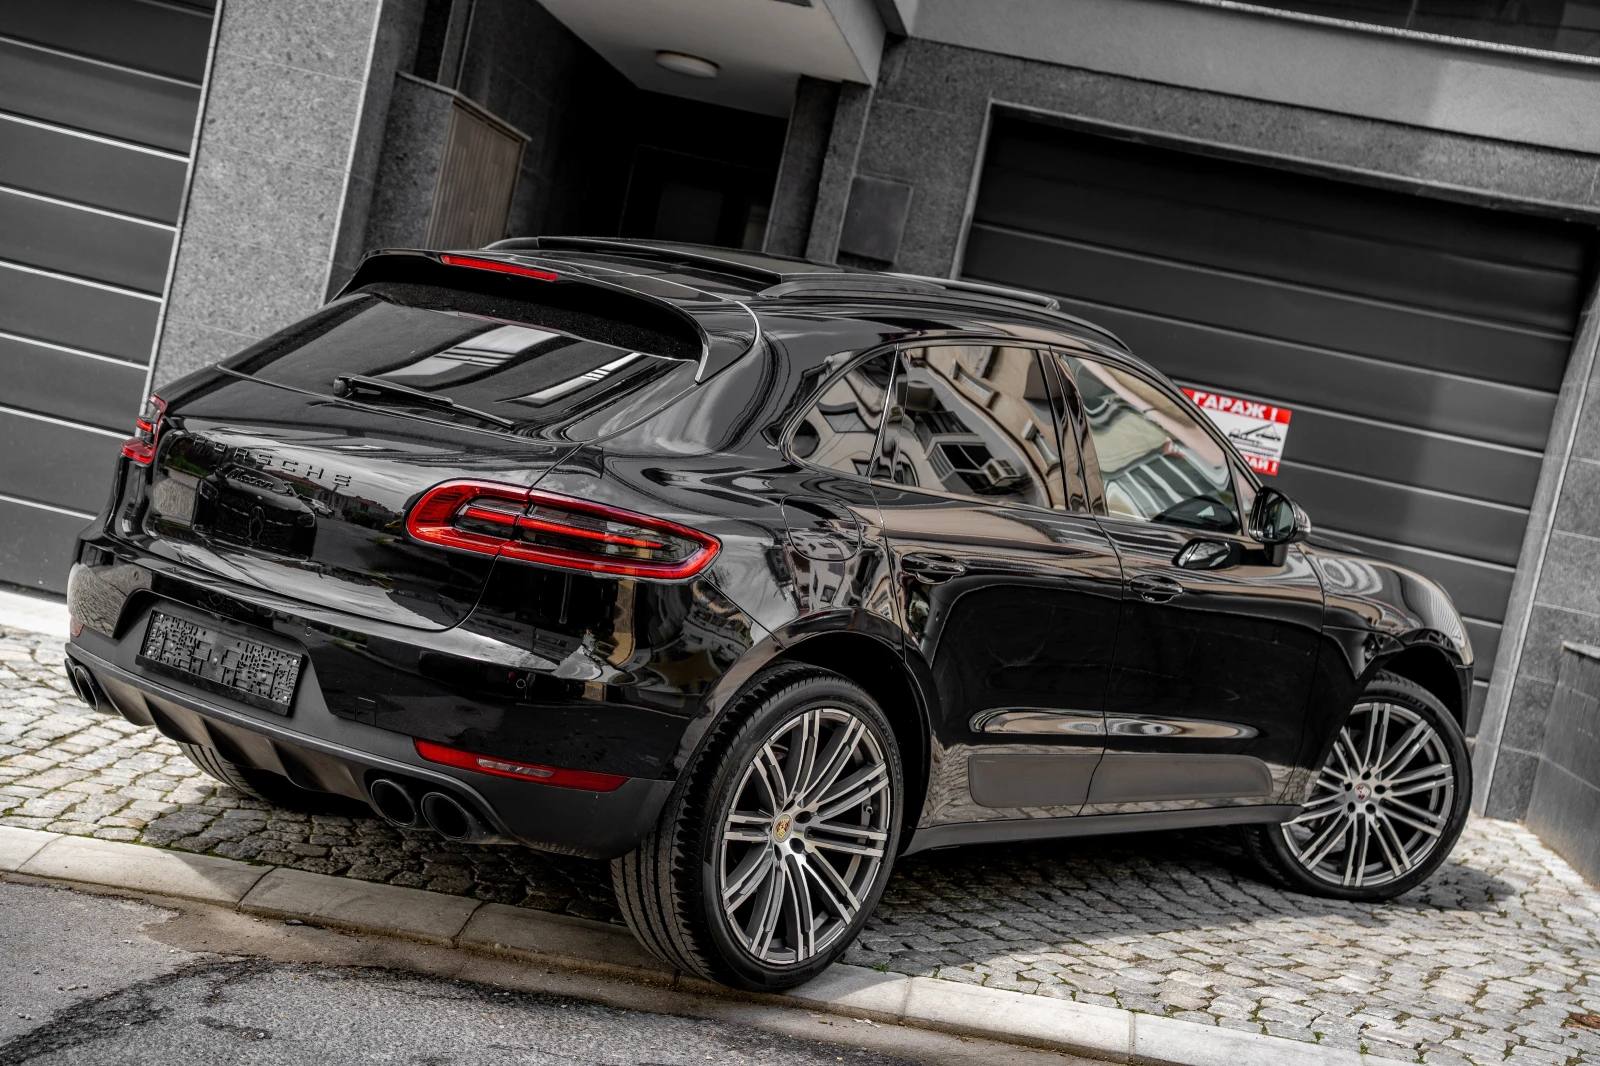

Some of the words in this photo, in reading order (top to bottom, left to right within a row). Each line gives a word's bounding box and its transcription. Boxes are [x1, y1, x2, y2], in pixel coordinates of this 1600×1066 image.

[1193, 391, 1267, 420] ГАРАЖ
[1270, 407, 1279, 421] !
[193, 435, 353, 487] PORSCHE
[225, 467, 275, 489] Macan
